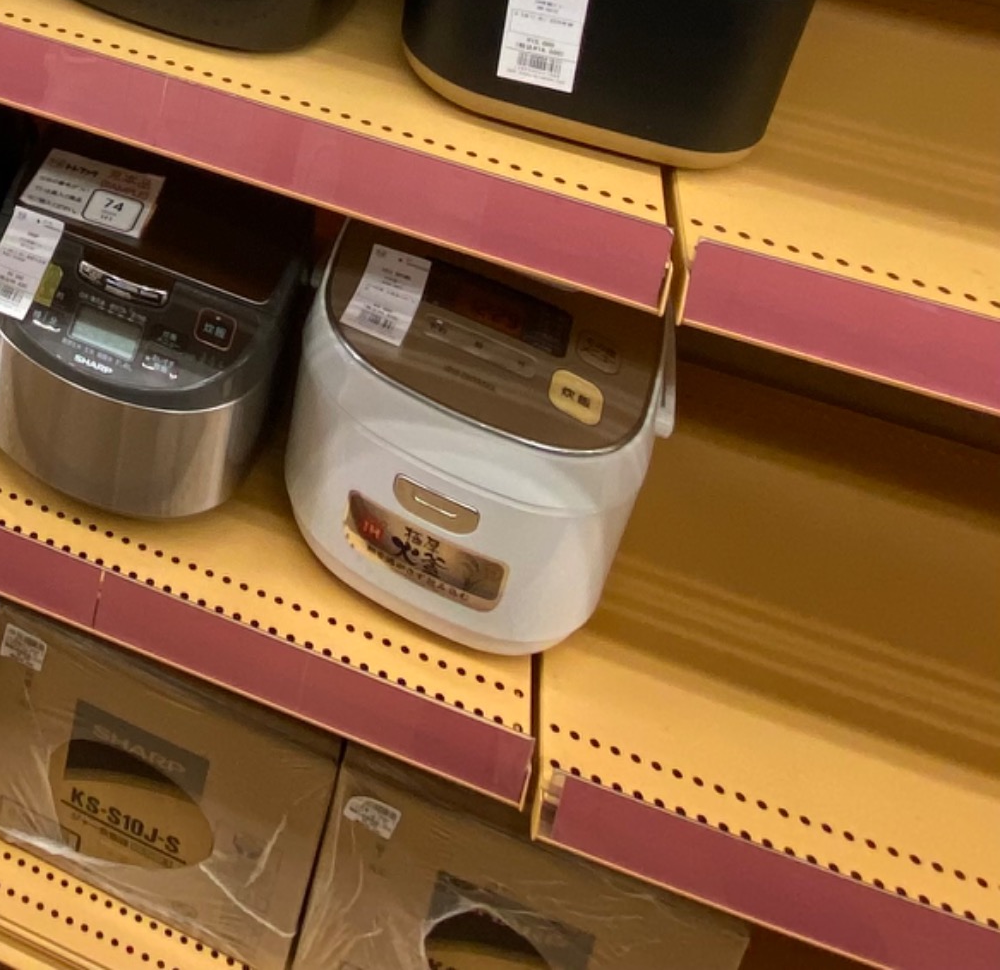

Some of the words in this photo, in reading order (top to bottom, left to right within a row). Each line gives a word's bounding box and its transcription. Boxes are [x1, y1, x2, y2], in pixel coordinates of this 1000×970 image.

[104, 196, 124, 213] 74
[74, 353, 114, 375] SHARP
[560, 386, 591, 409] 炊飯
[92, 724, 187, 775] SHARP
[70, 786, 182, 855] KS-S10J-S
